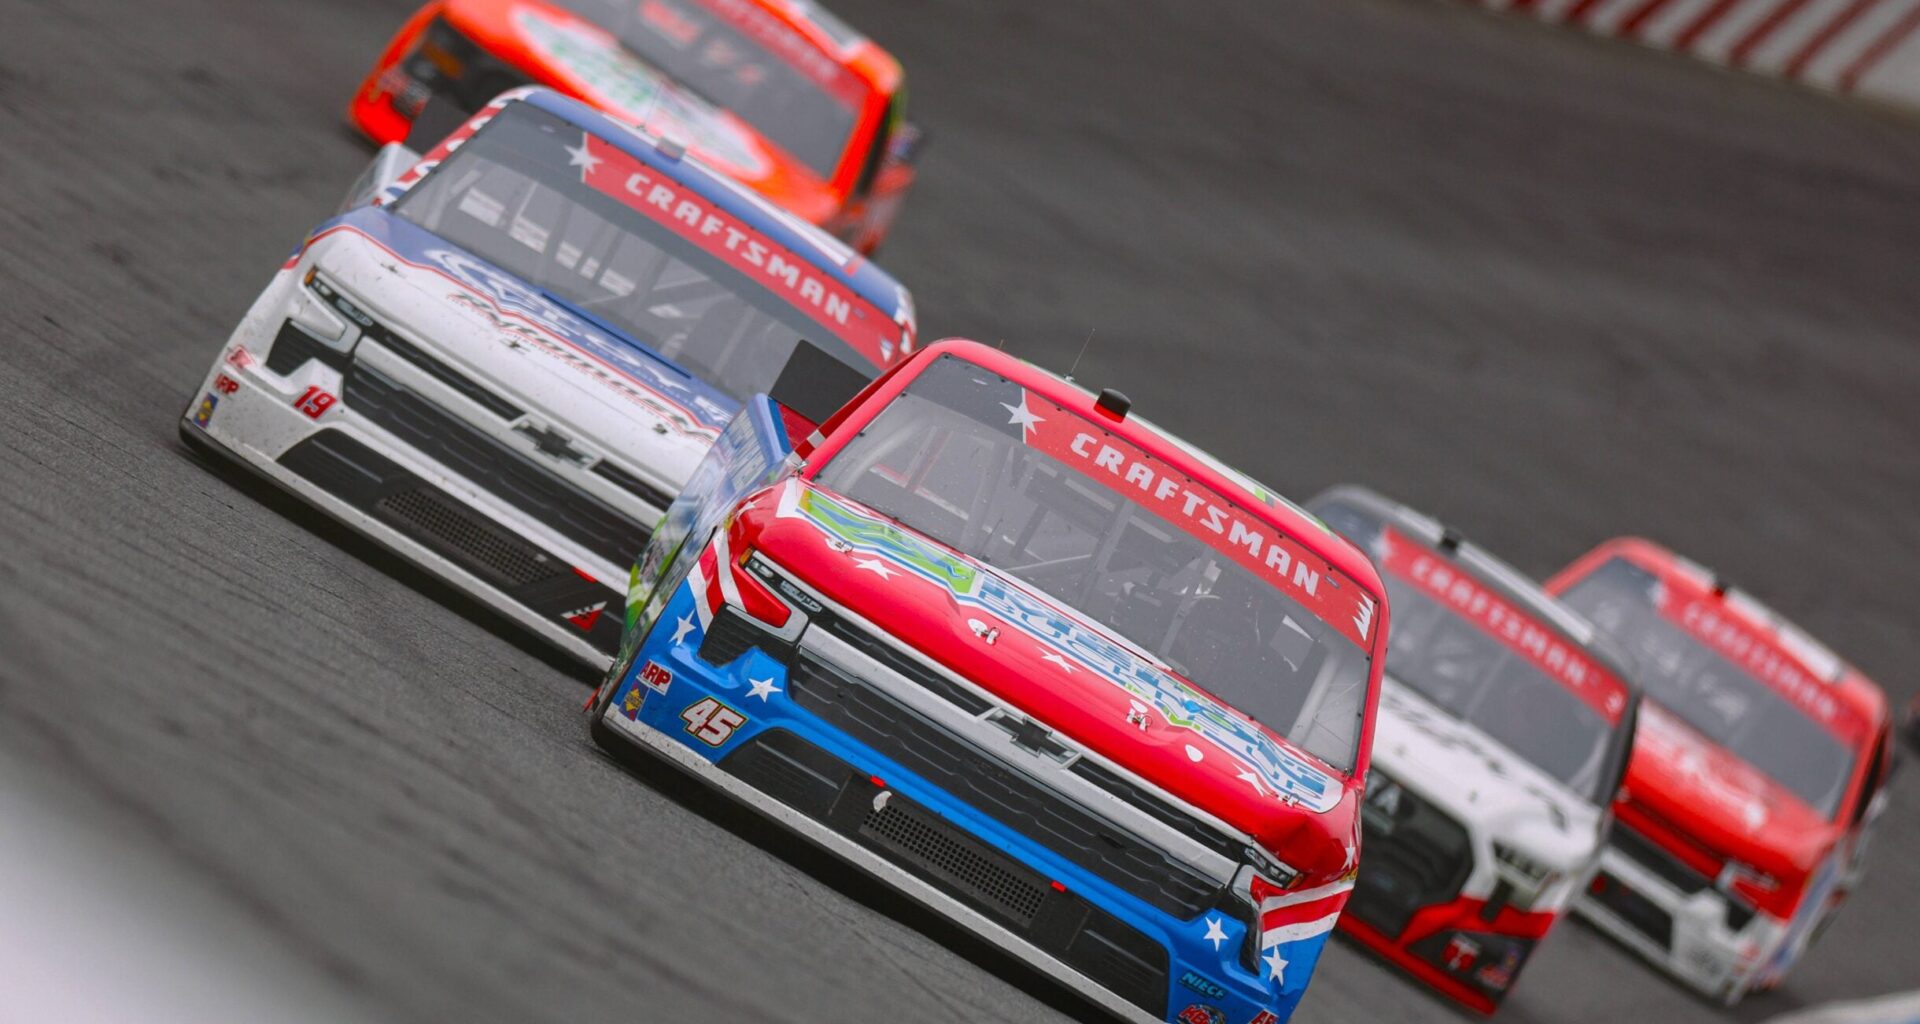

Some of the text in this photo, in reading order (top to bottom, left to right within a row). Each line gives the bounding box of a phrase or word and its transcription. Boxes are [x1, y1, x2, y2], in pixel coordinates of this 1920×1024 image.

[624, 173, 851, 325] CRAFTSMAN
[294, 384, 337, 420] 19
[1070, 432, 1319, 597] CRAFTSMAN
[1411, 556, 1587, 687] CRAFTSMAN
[641, 660, 671, 687] ARP
[680, 696, 748, 747] 45
